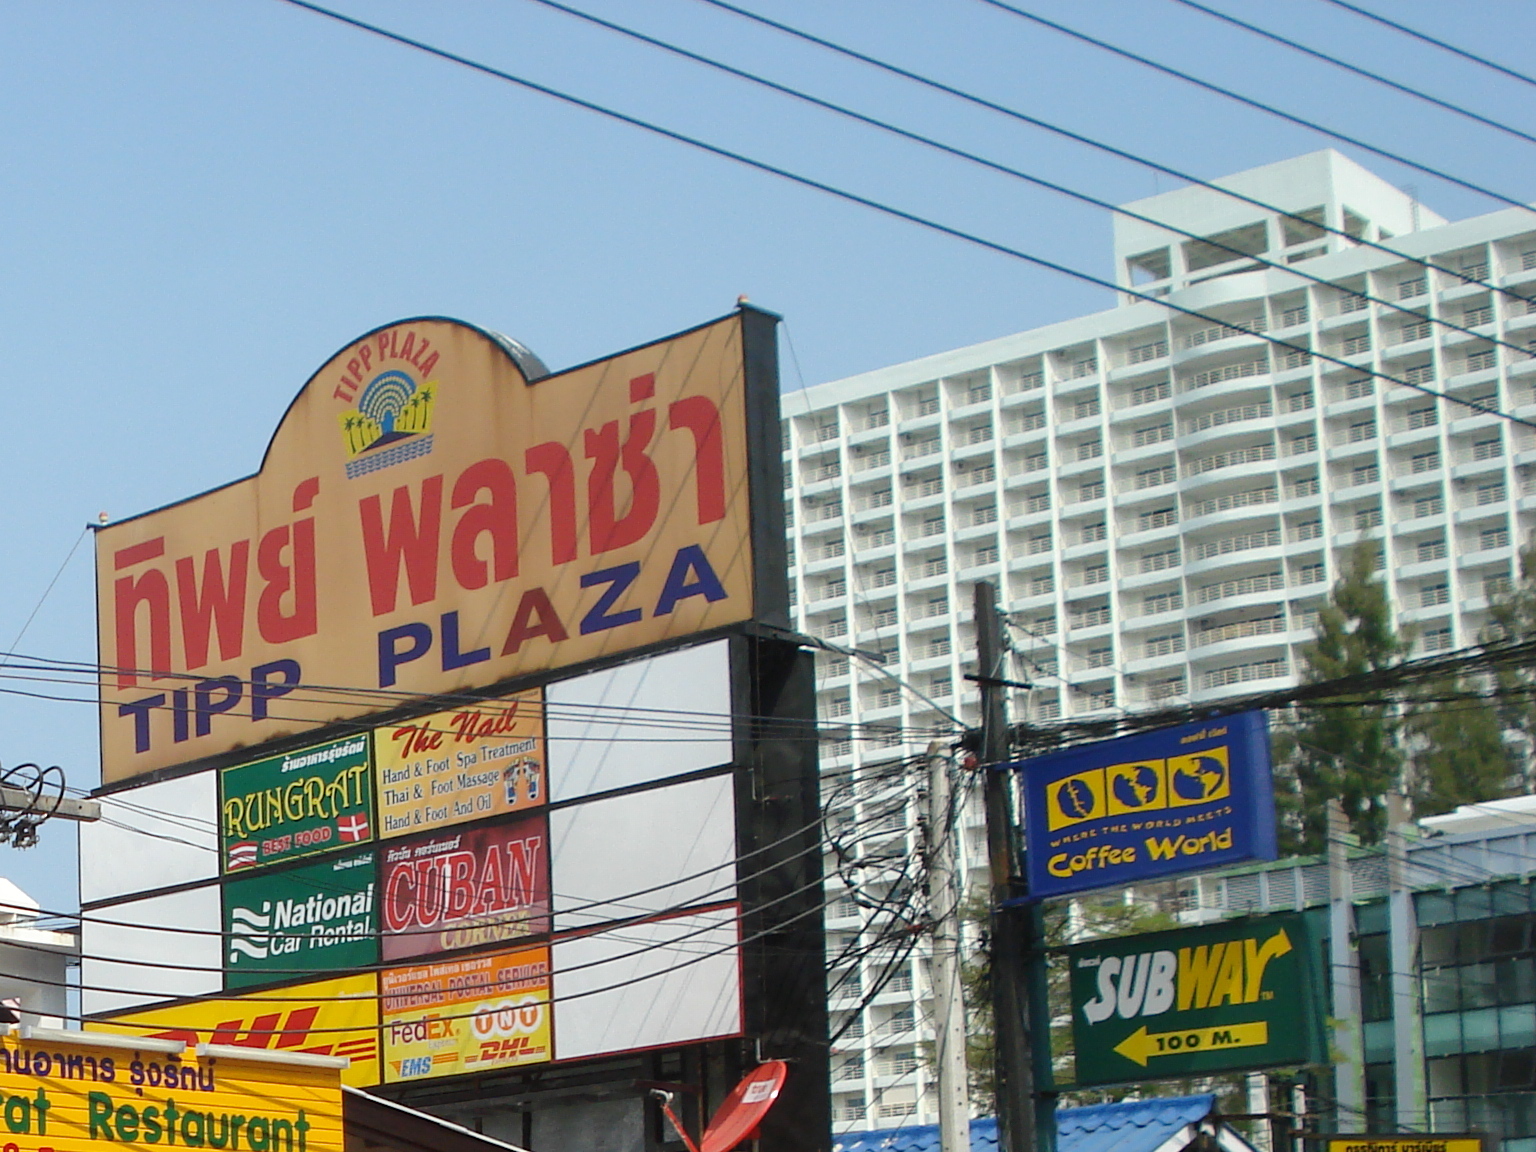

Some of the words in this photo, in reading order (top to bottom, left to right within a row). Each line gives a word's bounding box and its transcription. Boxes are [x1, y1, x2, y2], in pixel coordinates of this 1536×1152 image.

[333, 344, 372, 403] TIPP
[378, 330, 440, 379] PLAZA
[114, 475, 321, 691] ทิพย์
[359, 372, 725, 618] พลาซ่า
[119, 658, 302, 754] TIPP
[378, 542, 728, 689] PLAZA
[392, 721, 443, 759] The
[450, 698, 519, 743] Nail
[382, 764, 410, 785] Hand
[414, 763, 423, 777] &
[426, 758, 450, 775] Foot
[456, 751, 477, 769] Spa
[480, 737, 536, 762] Treatment
[224, 761, 368, 838] RUNGRAT
[384, 788, 409, 806] Thai
[413, 784, 423, 800] &
[431, 779, 454, 796] Foot
[457, 769, 500, 790] Massage
[384, 812, 410, 831] Hand
[414, 809, 423, 824] &
[425, 807, 448, 823] Foot
[453, 798, 473, 817] And
[476, 793, 492, 812] Oil
[1050, 829, 1098, 847] WHERE
[1101, 824, 1127, 835] THE
[1131, 819, 1182, 831] WORLD
[1185, 806, 1233, 824] MEETS
[262, 835, 292, 857] BEST
[295, 826, 332, 848] FOOD
[1047, 845, 1136, 878] Coffee
[1145, 826, 1233, 861] World
[273, 883, 375, 930] National
[385, 836, 541, 933] CUBAN
[270, 932, 302, 955] Car
[309, 915, 371, 949] Rental
[385, 979, 444, 1010] UNIVERSAL
[448, 971, 493, 999] POSTAL
[497, 962, 547, 992] SERVICE
[1083, 927, 1292, 1026] SUBWAY
[390, 1013, 455, 1046] FedEx
[476, 1002, 538, 1034] TNT
[1156, 1034, 1201, 1052] 100
[1211, 1030, 1241, 1046] M.
[401, 1056, 432, 1078] EMS
[479, 1036, 535, 1061] DHL
